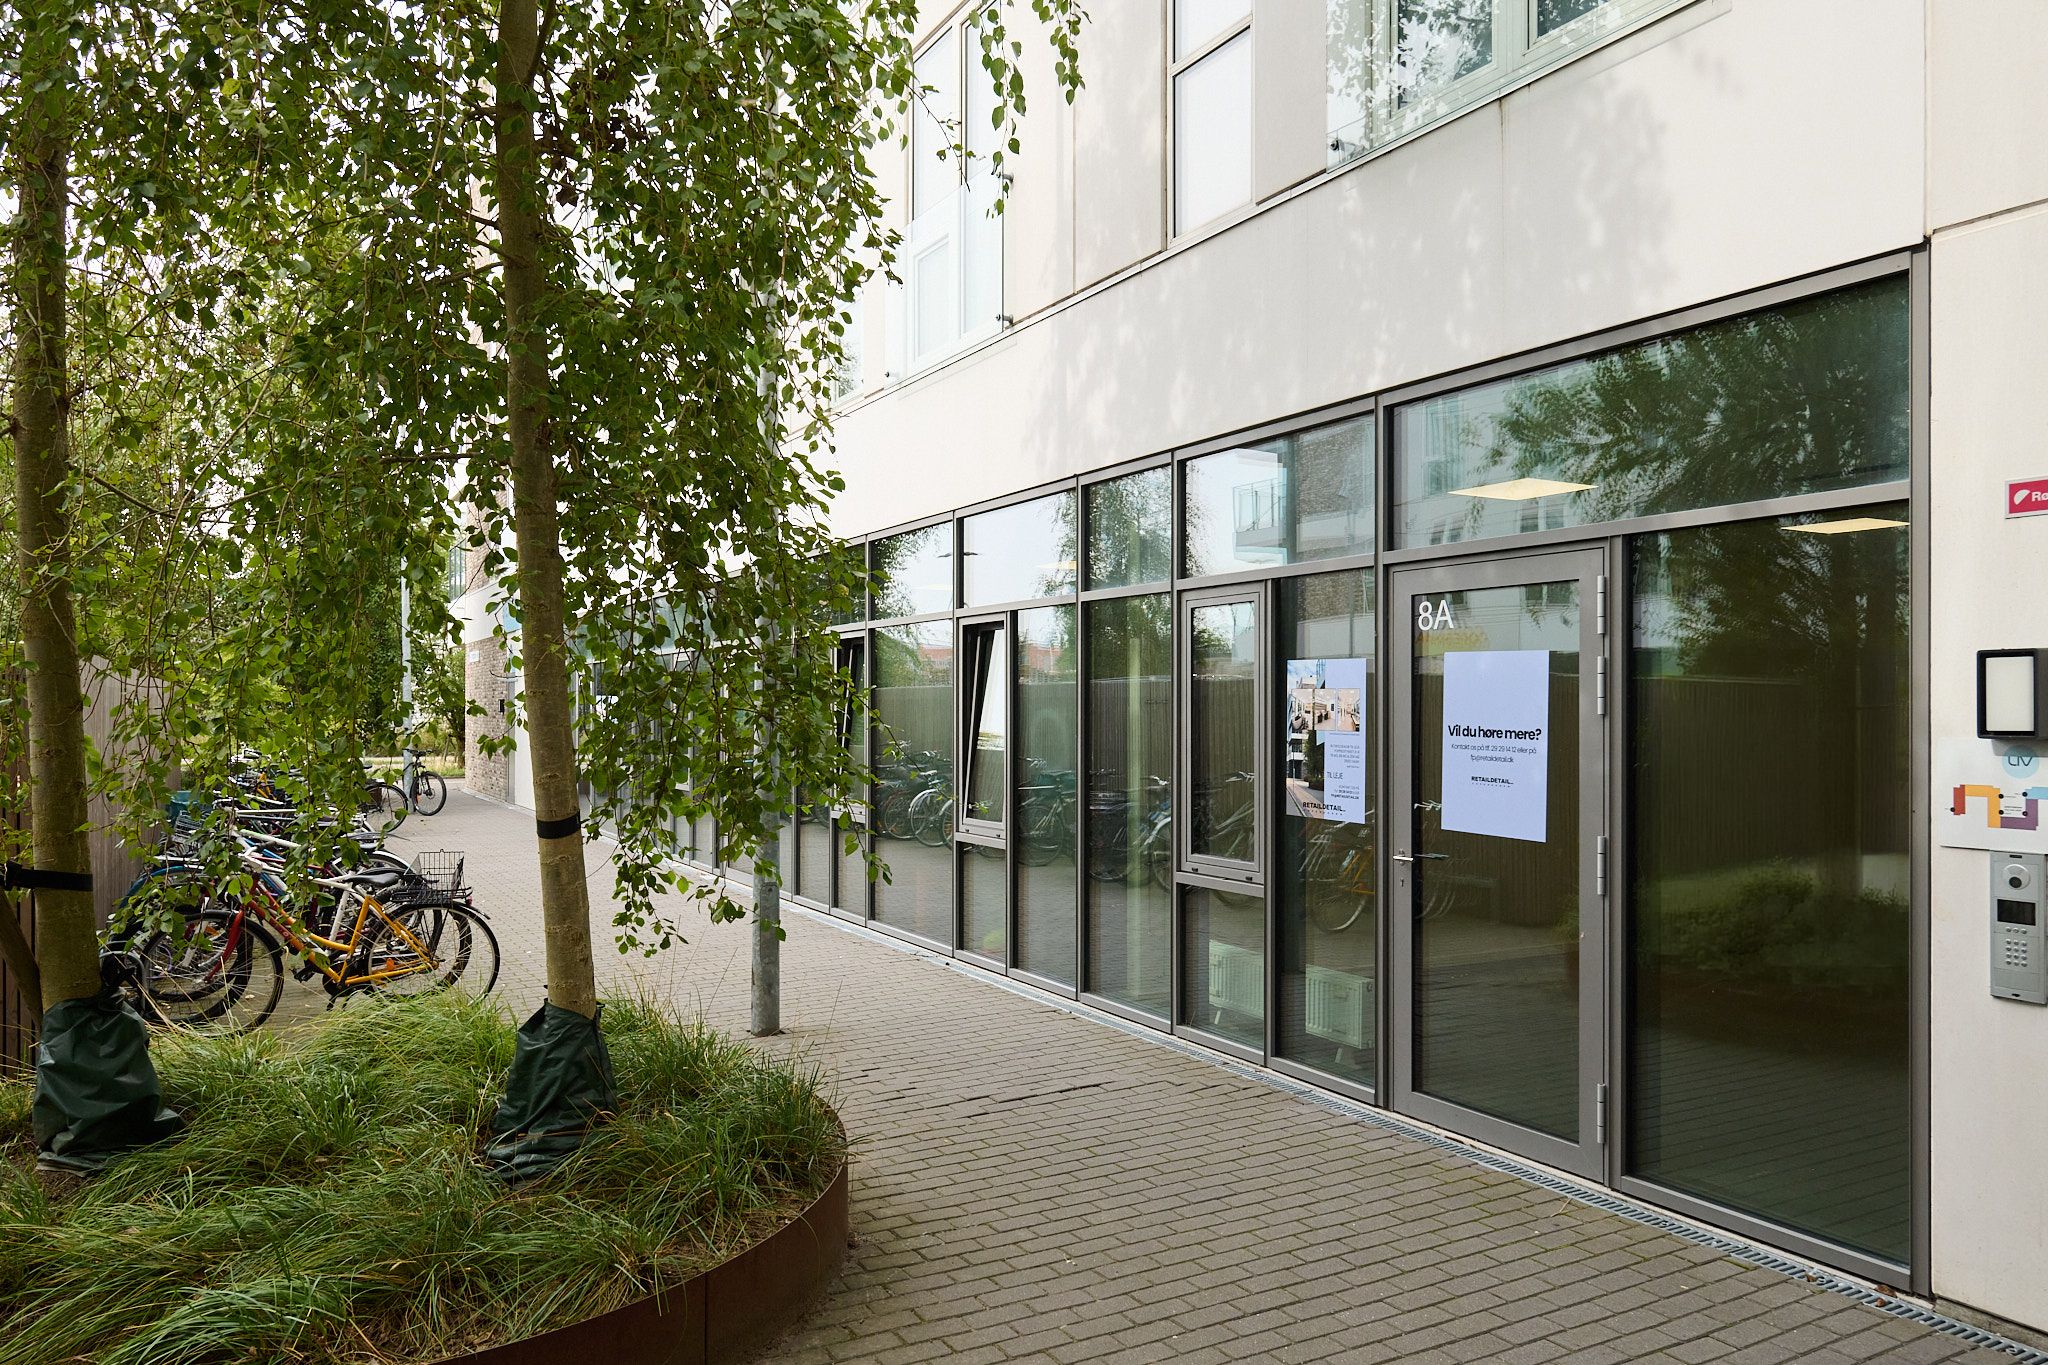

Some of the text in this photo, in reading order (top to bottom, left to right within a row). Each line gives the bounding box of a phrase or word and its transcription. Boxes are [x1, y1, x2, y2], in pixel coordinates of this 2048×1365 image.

[1418, 599, 1455, 631] 8A
[1448, 724, 1542, 741] Vil du høre mere?
[1477, 743, 1485, 752] på
[1498, 745, 1505, 753] 29
[1517, 746, 1528, 754] eller
[1528, 747, 1537, 757] på
